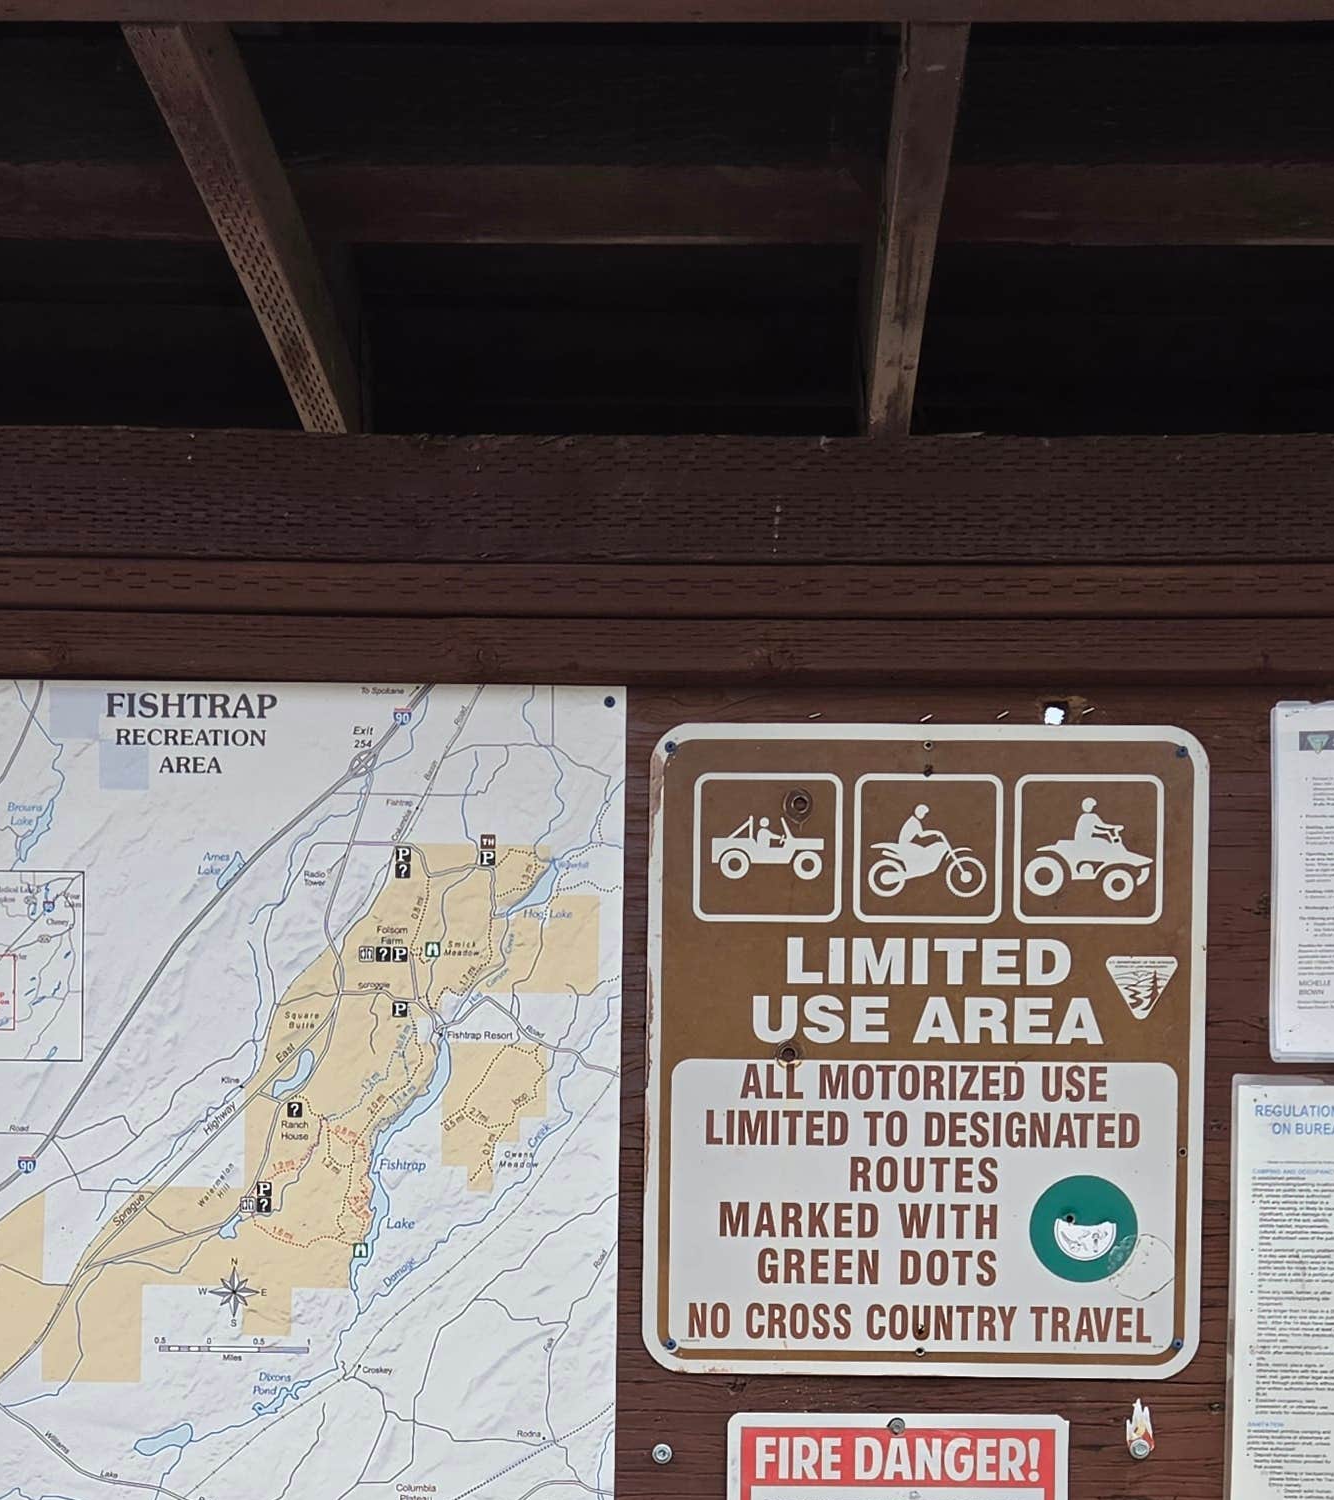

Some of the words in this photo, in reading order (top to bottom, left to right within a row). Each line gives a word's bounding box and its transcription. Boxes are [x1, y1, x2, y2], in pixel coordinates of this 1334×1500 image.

[106, 694, 278, 719] FISHTRAP
[115, 728, 266, 747] RECREATION
[159, 756, 222, 774] AREA
[377, 925, 408, 934] Folsom
[381, 937, 403, 945] Farm
[786, 938, 1071, 985] LIMITED
[447, 1030, 485, 1041] Fishtrap
[488, 1031, 513, 1040] Resort
[753, 995, 889, 1043] USE
[912, 998, 1103, 1045] AREA
[740, 1063, 803, 1099] ALL
[819, 1064, 1023, 1100] MOTORIZED
[1042, 1065, 1108, 1102] USE
[706, 1110, 847, 1146] LIMITED
[864, 1111, 908, 1147] TO
[923, 1112, 1140, 1148] DESIGNATED
[379, 1158, 425, 1173] Fishtrap
[850, 1157, 999, 1192] ROUTES
[386, 1217, 415, 1230] Lake
[720, 1203, 877, 1238] MARKED
[899, 1203, 998, 1239] WITH
[758, 1249, 880, 1285] GREEN
[899, 1250, 997, 1285] DOTS
[687, 1303, 730, 1338] NO
[745, 1303, 850, 1339] CROSS
[867, 1304, 1016, 1341] COUNTRY
[1031, 1306, 1152, 1342] TRAVEL
[755, 1437, 840, 1480] FIRE
[855, 1438, 1041, 1482] DANGER!
